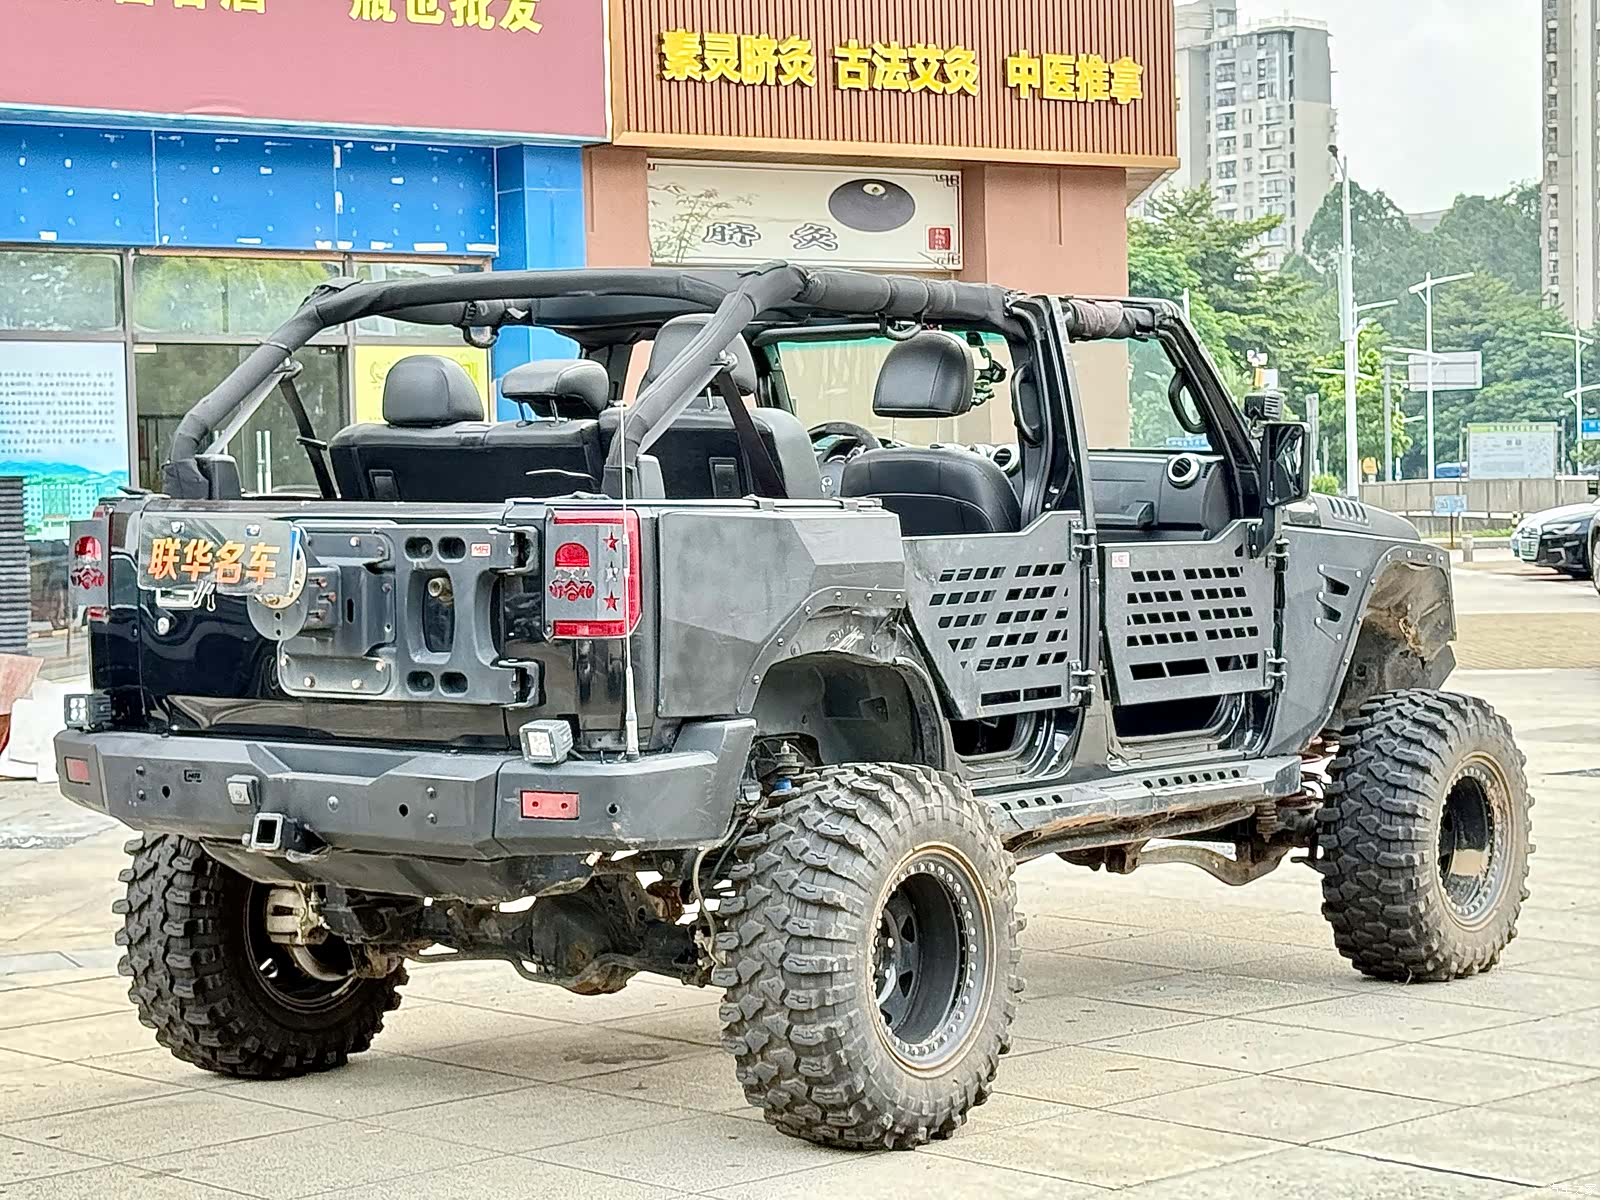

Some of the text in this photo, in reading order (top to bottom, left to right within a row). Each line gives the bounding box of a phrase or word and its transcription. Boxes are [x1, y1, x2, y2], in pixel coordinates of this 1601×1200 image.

[660, 29, 1144, 105] 素灵脐灸 古法艾灸 中医推拿
[147, 537, 280, 585] 联华名车
